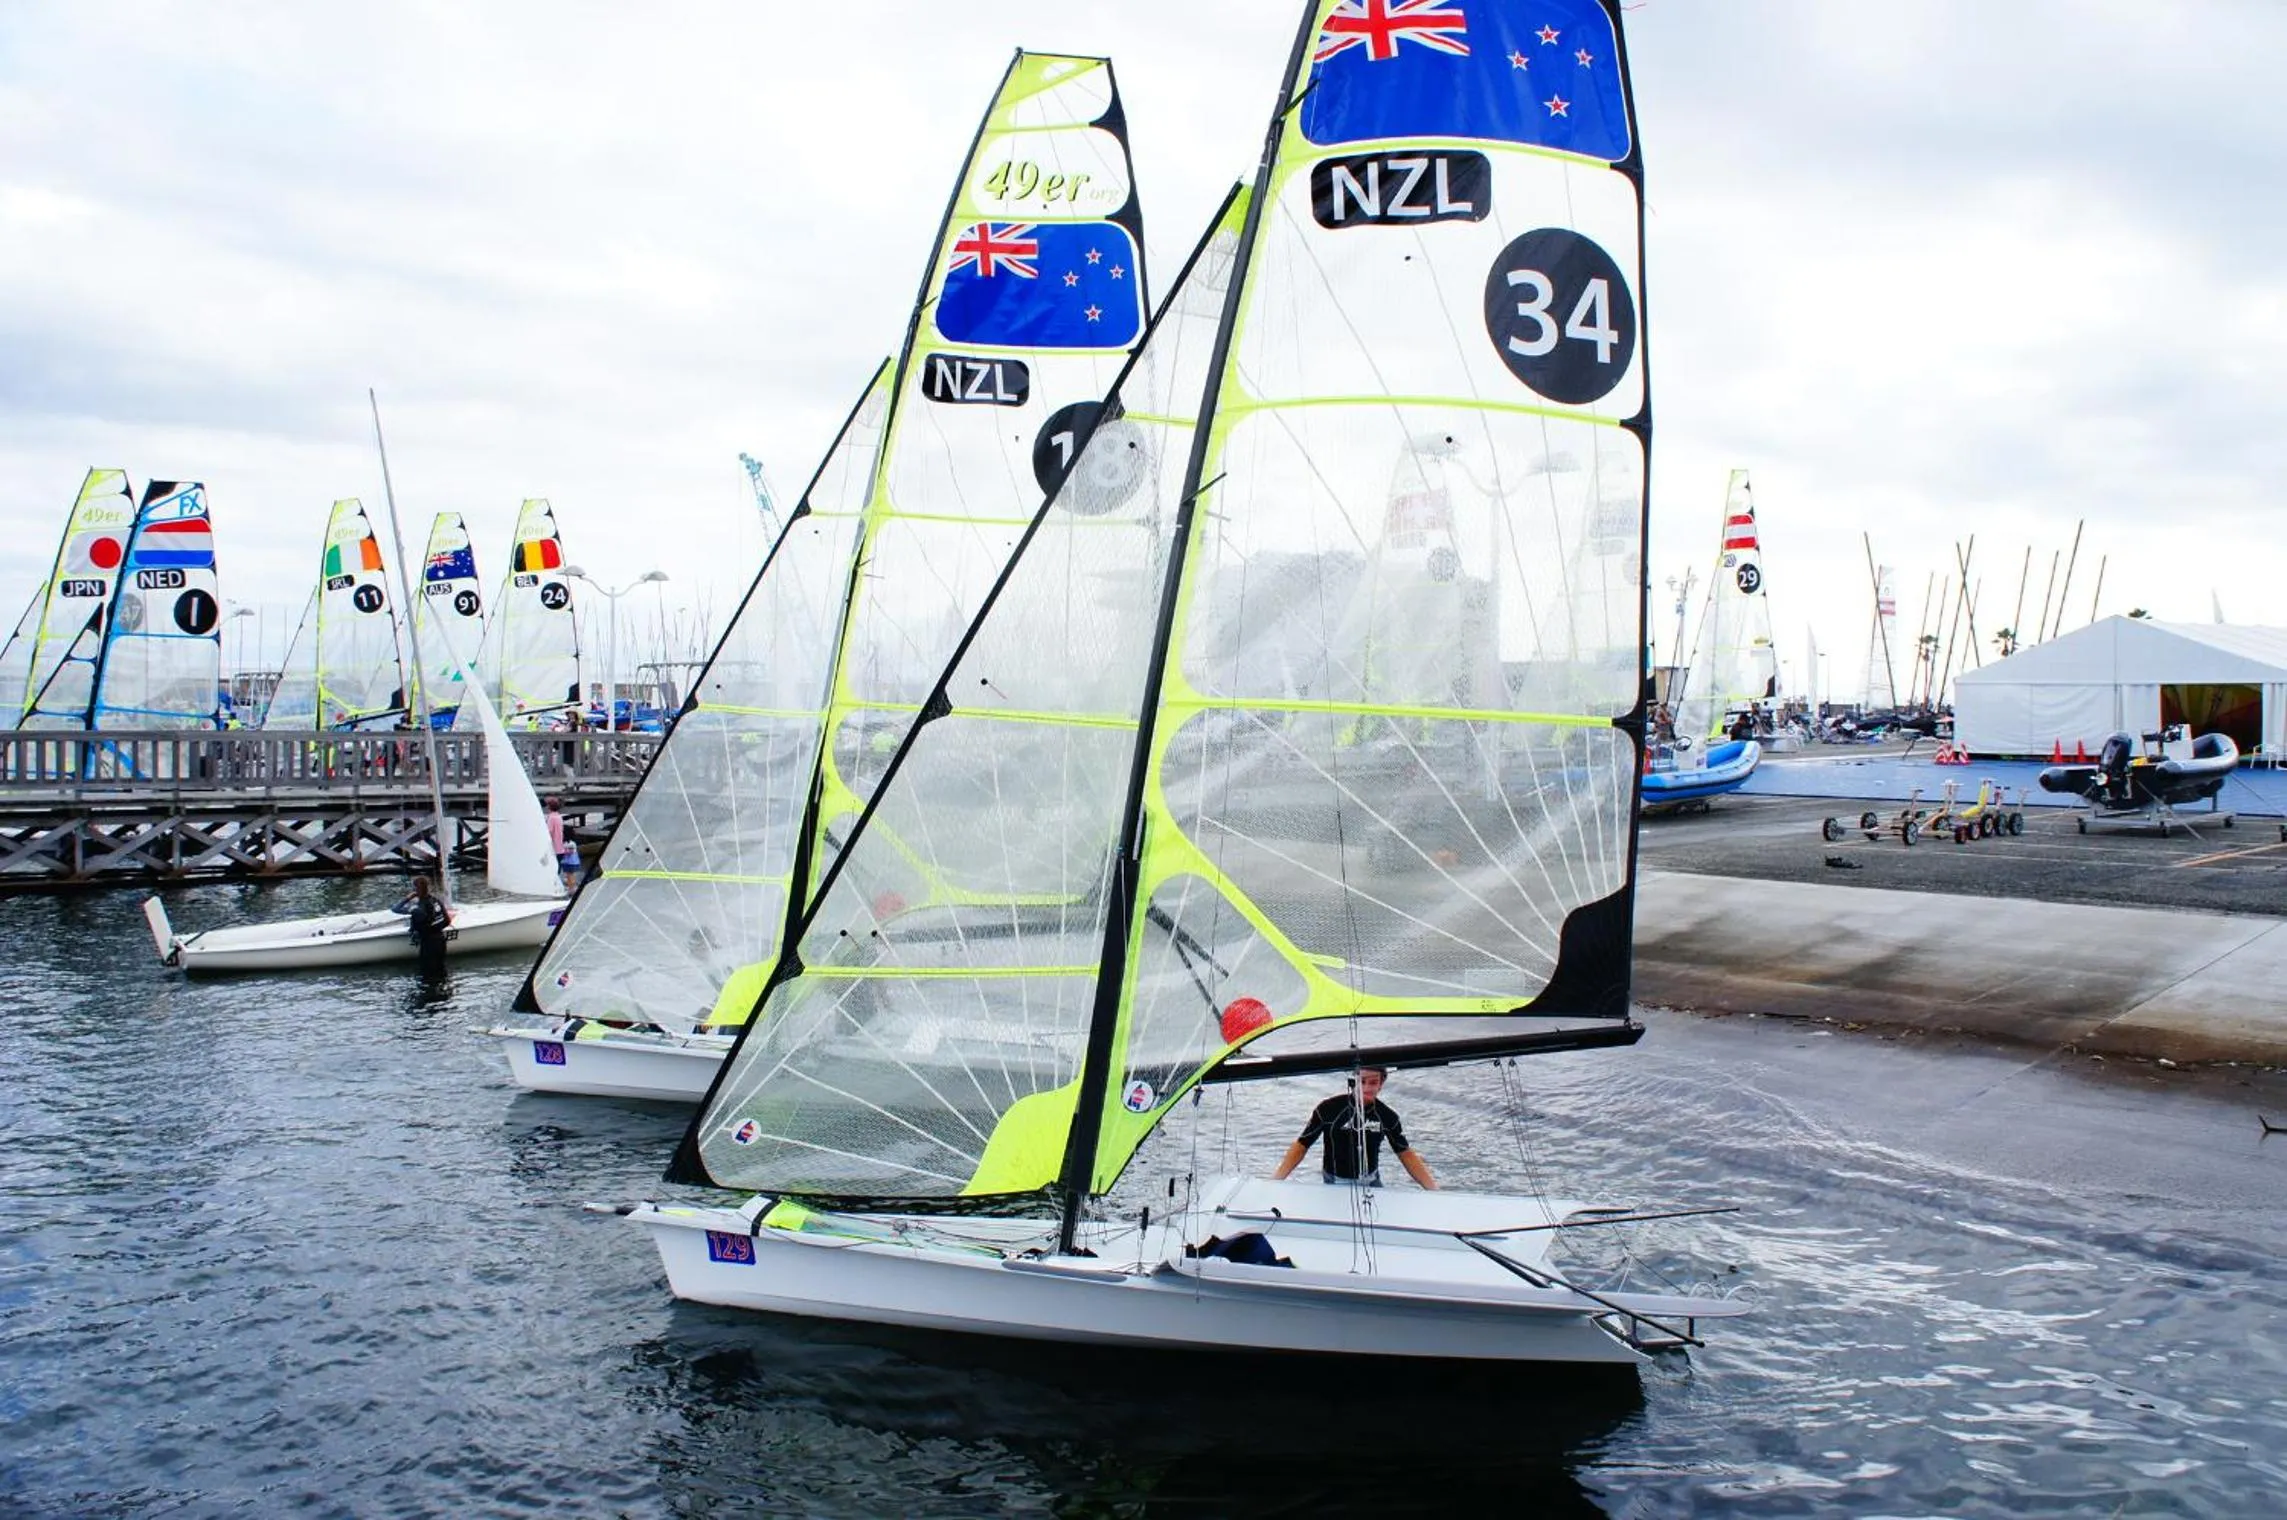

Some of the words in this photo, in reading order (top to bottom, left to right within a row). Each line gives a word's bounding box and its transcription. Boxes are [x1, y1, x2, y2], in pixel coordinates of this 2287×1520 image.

[983, 160, 1091, 202] 49er
[1331, 157, 1473, 221] NZL
[1506, 269, 1619, 364] 34
[934, 359, 1019, 402] NZL
[179, 492, 202, 516] FX
[64, 582, 101, 596] JPN
[138, 571, 182, 588] NED
[1738, 571, 1758, 588] 29
[358, 589, 380, 608] 11
[458, 596, 477, 611] 91
[544, 588, 566, 605] 24
[710, 1231, 750, 1260] 129
